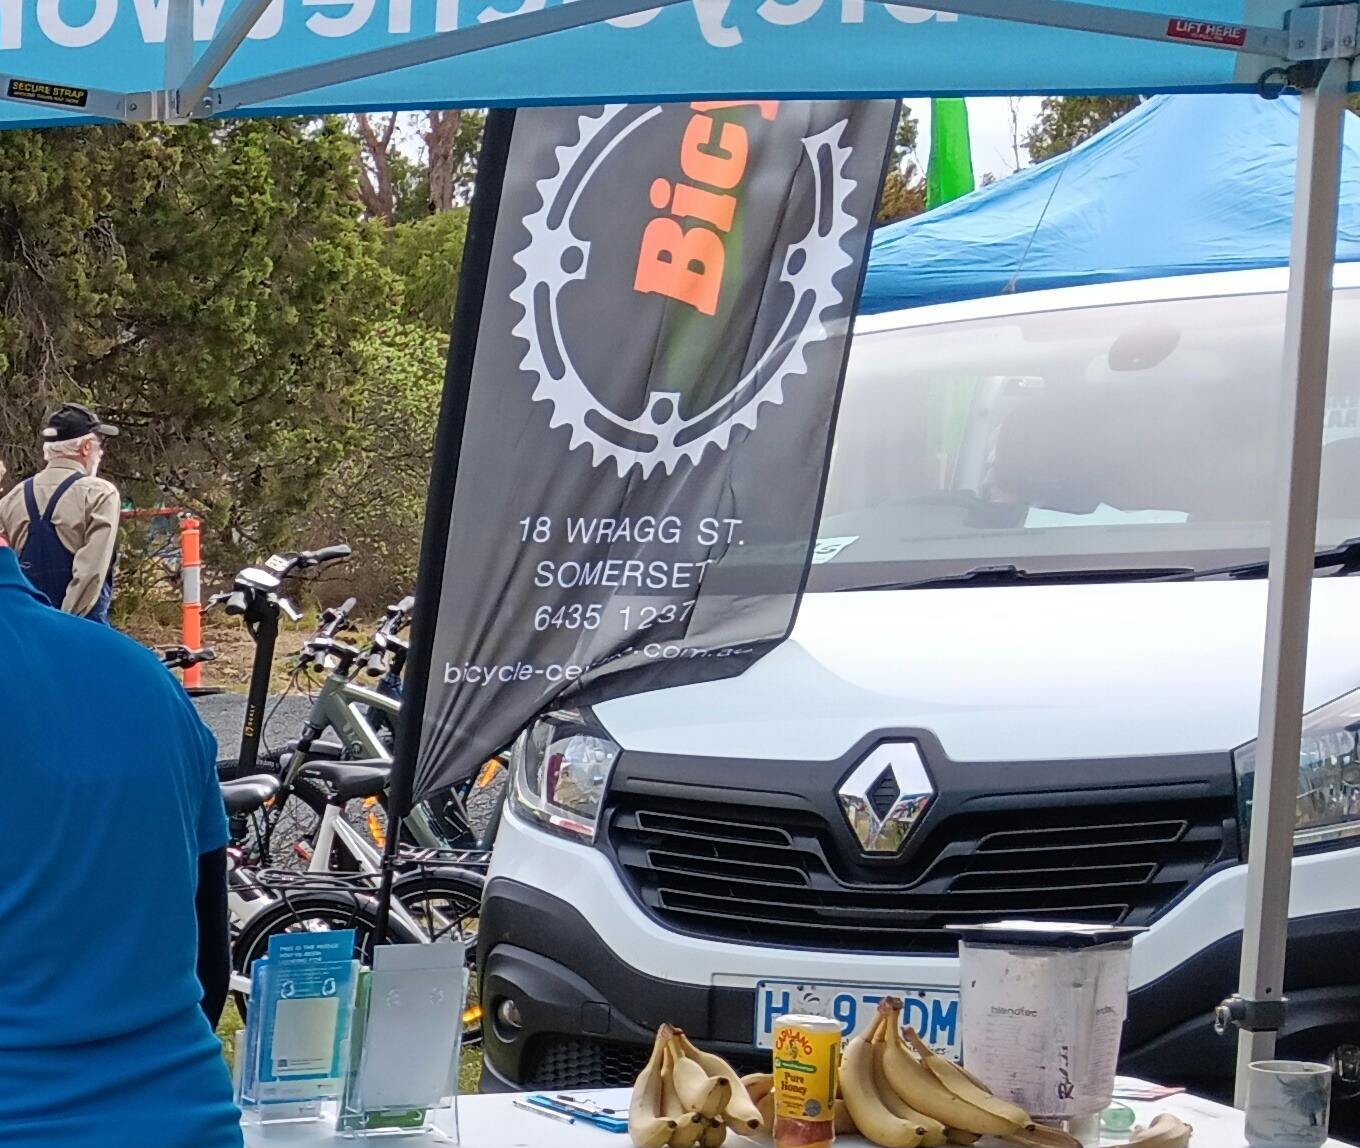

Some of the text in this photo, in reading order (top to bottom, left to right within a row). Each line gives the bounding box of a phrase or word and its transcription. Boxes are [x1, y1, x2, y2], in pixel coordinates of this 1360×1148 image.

[1176, 20, 1203, 33] LIFT
[1205, 24, 1241, 38] HERE
[12, 81, 50, 95] SECURE
[52, 87, 85, 99] STRAP
[519, 515, 745, 547] 18 WRAGG ST.
[533, 559, 714, 589] SOMERSET
[533, 599, 696, 632] 6435 1237
[764, 990, 790, 1034] H
[990, 1005, 1038, 1018] blendtec
[784, 1071, 805, 1084] Pure
[780, 1080, 808, 1097] Honey
